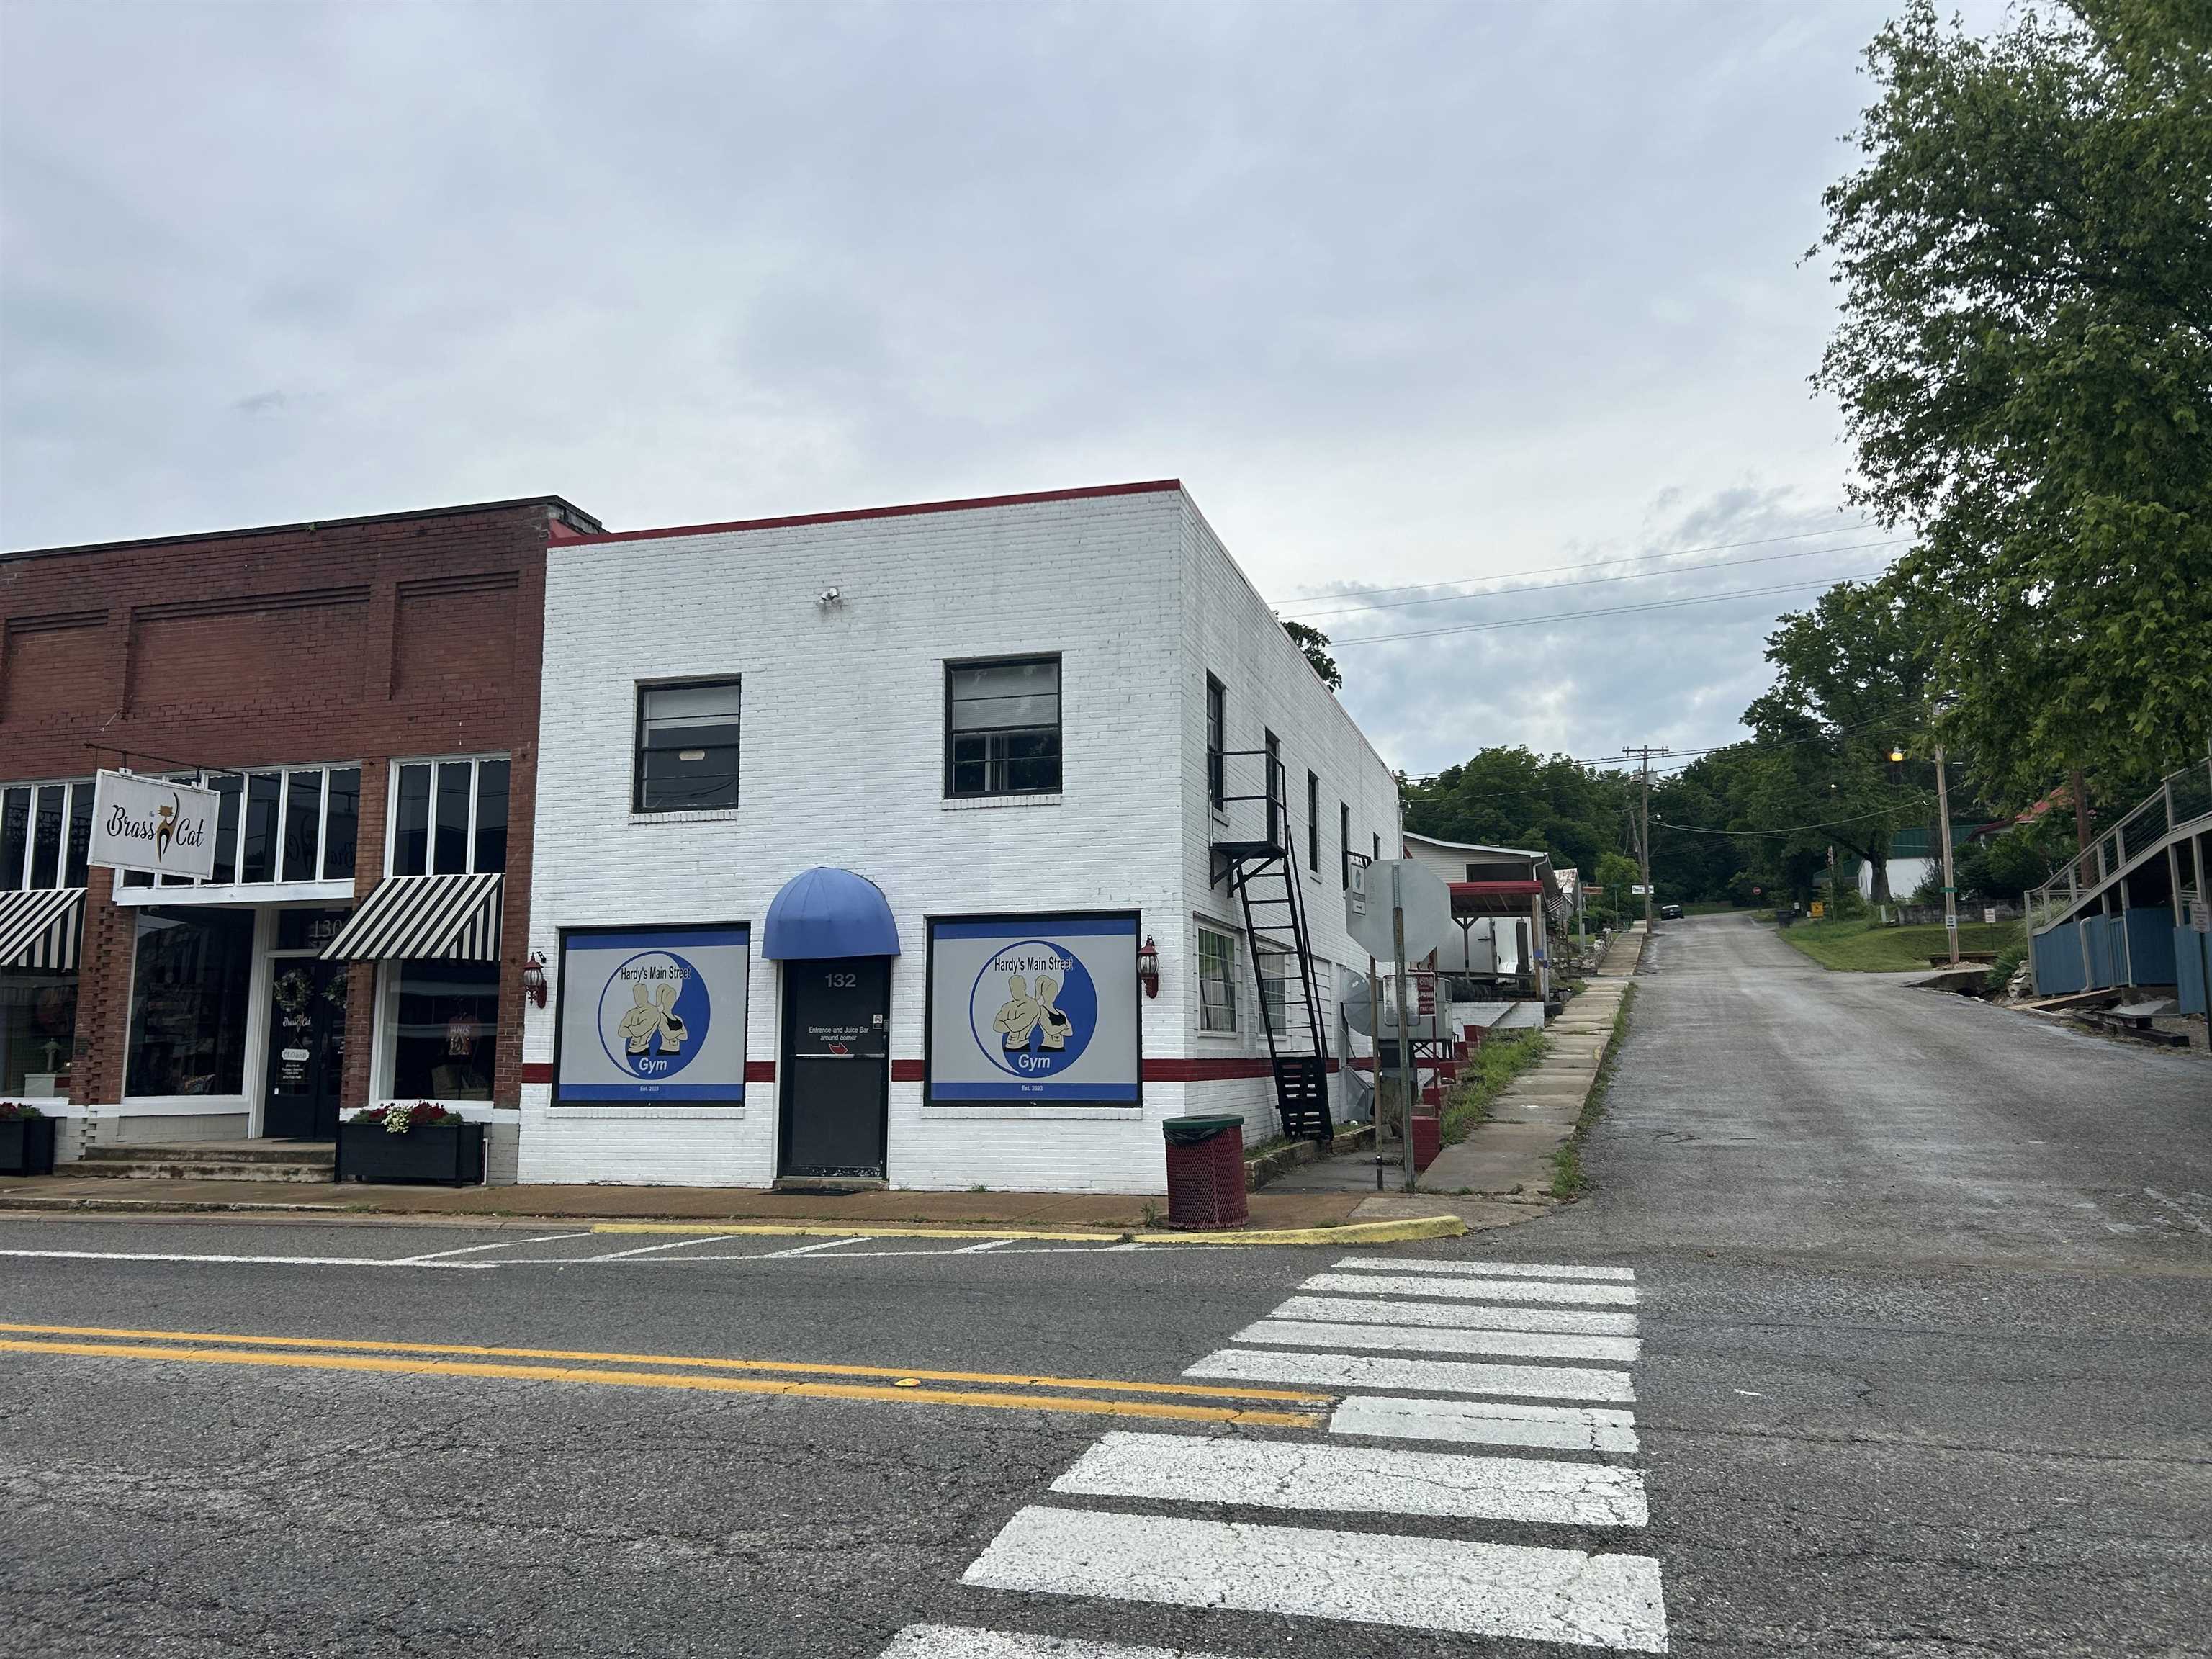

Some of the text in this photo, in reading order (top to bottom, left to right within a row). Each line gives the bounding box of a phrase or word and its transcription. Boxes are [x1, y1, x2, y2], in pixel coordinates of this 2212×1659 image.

[107, 804, 205, 848] Brass Cat
[994, 956, 1073, 975] Hardy's Main Street
[621, 966, 691, 983] Hardy's Main Street
[824, 973, 857, 988] 132
[639, 1057, 667, 1074] Gym
[1018, 1053, 1051, 1071] Gym
